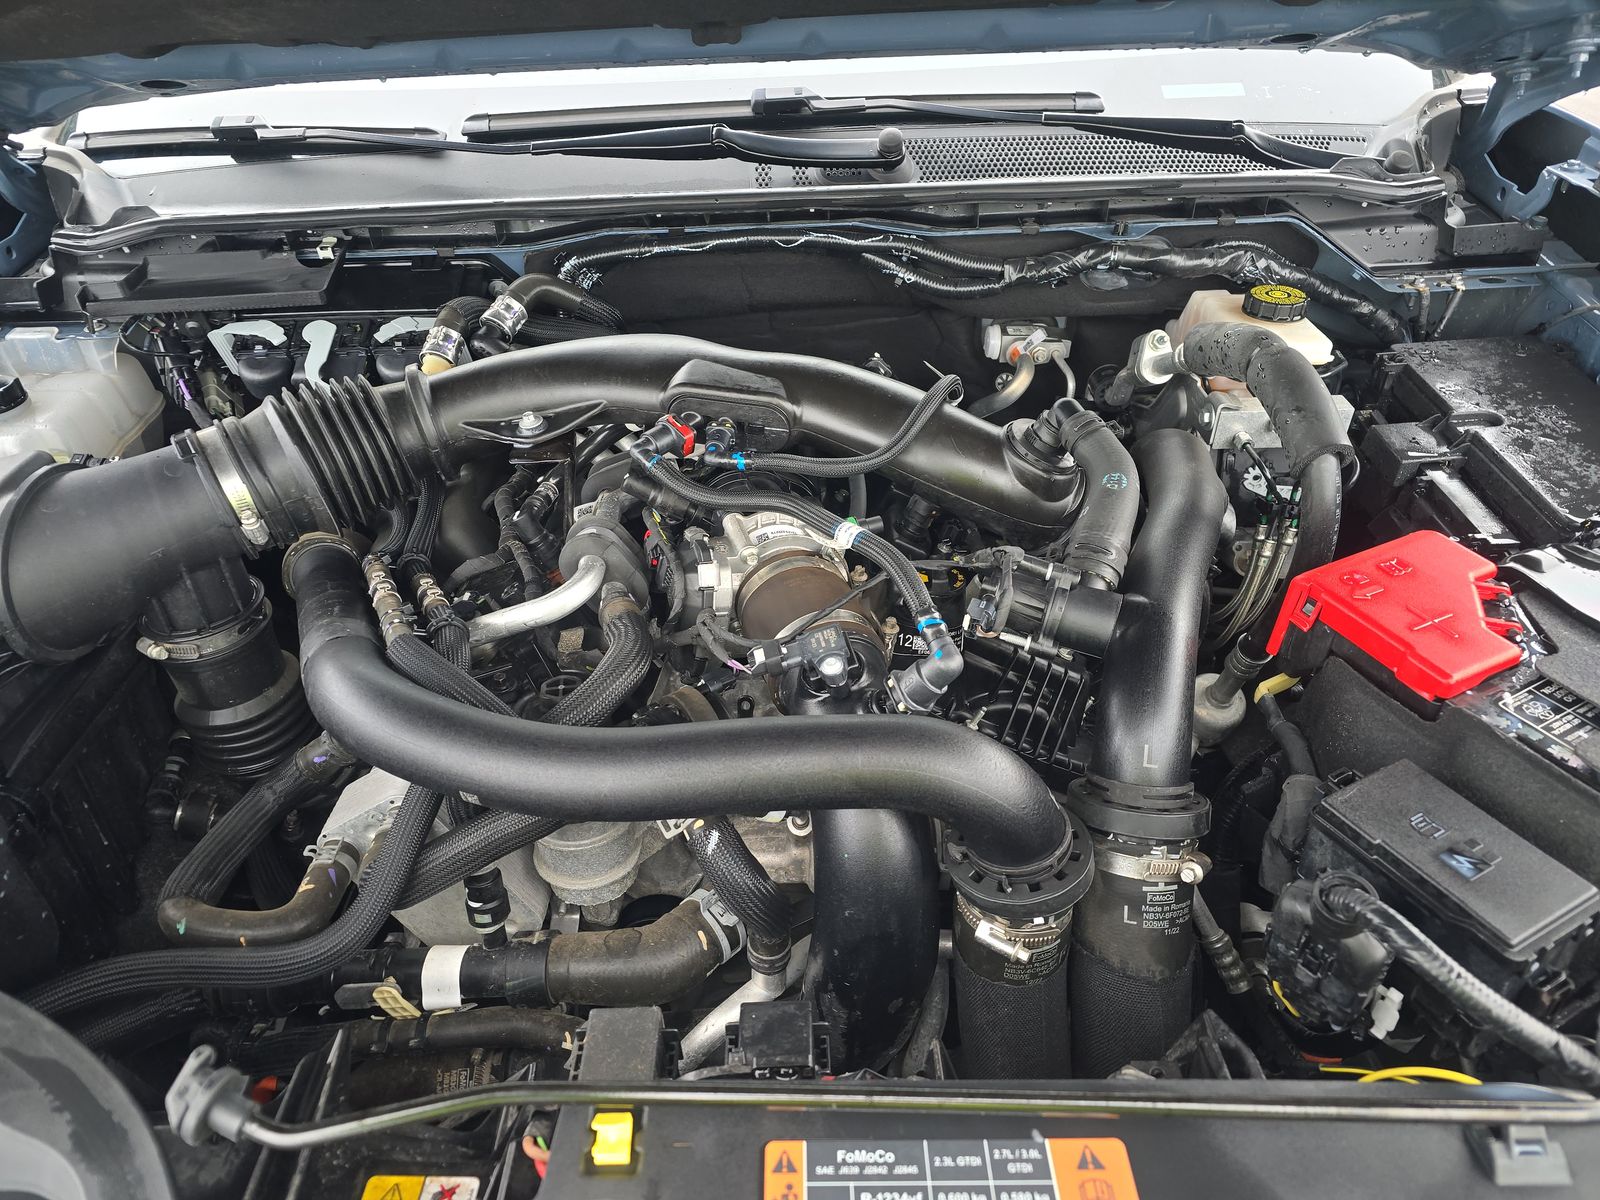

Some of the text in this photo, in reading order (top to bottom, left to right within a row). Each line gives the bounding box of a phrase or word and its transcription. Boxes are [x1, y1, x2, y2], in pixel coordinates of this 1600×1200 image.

[1143, 744, 1158, 768] L
[1147, 893, 1174, 903] FoMoCo
[1142, 904, 1162, 912] Made
[1124, 905, 1137, 925] L
[1164, 927, 1180, 936] 11/22
[836, 1149, 896, 1164] FoMoCo
[815, 1165, 835, 1175] SAE
